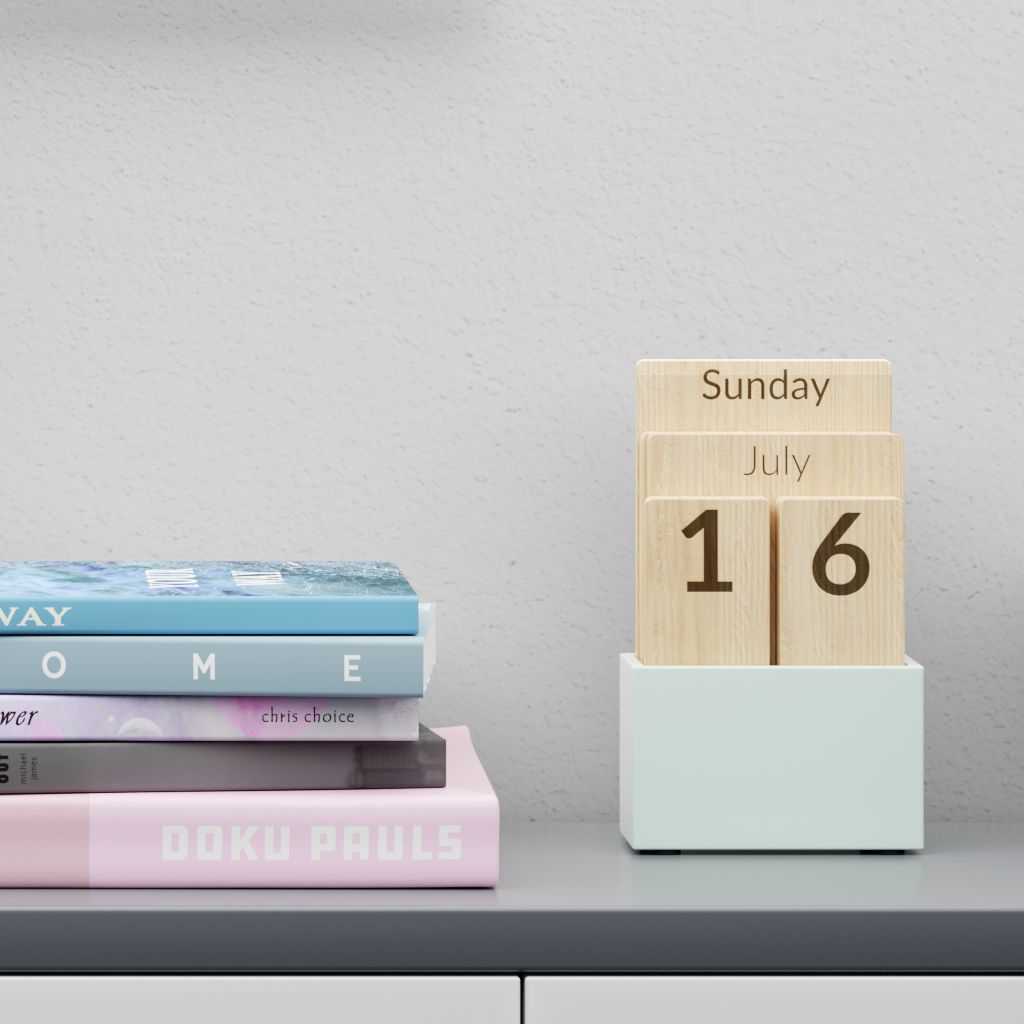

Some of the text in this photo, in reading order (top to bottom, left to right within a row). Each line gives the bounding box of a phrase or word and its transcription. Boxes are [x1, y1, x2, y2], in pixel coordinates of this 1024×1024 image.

[701, 369, 831, 407] Sunday
[743, 445, 812, 482] July
[261, 706, 355, 723] chris choice
[19, 752, 28, 785] michael
[30, 756, 39, 781] james
[162, 824, 463, 861] DOKU PAULS
